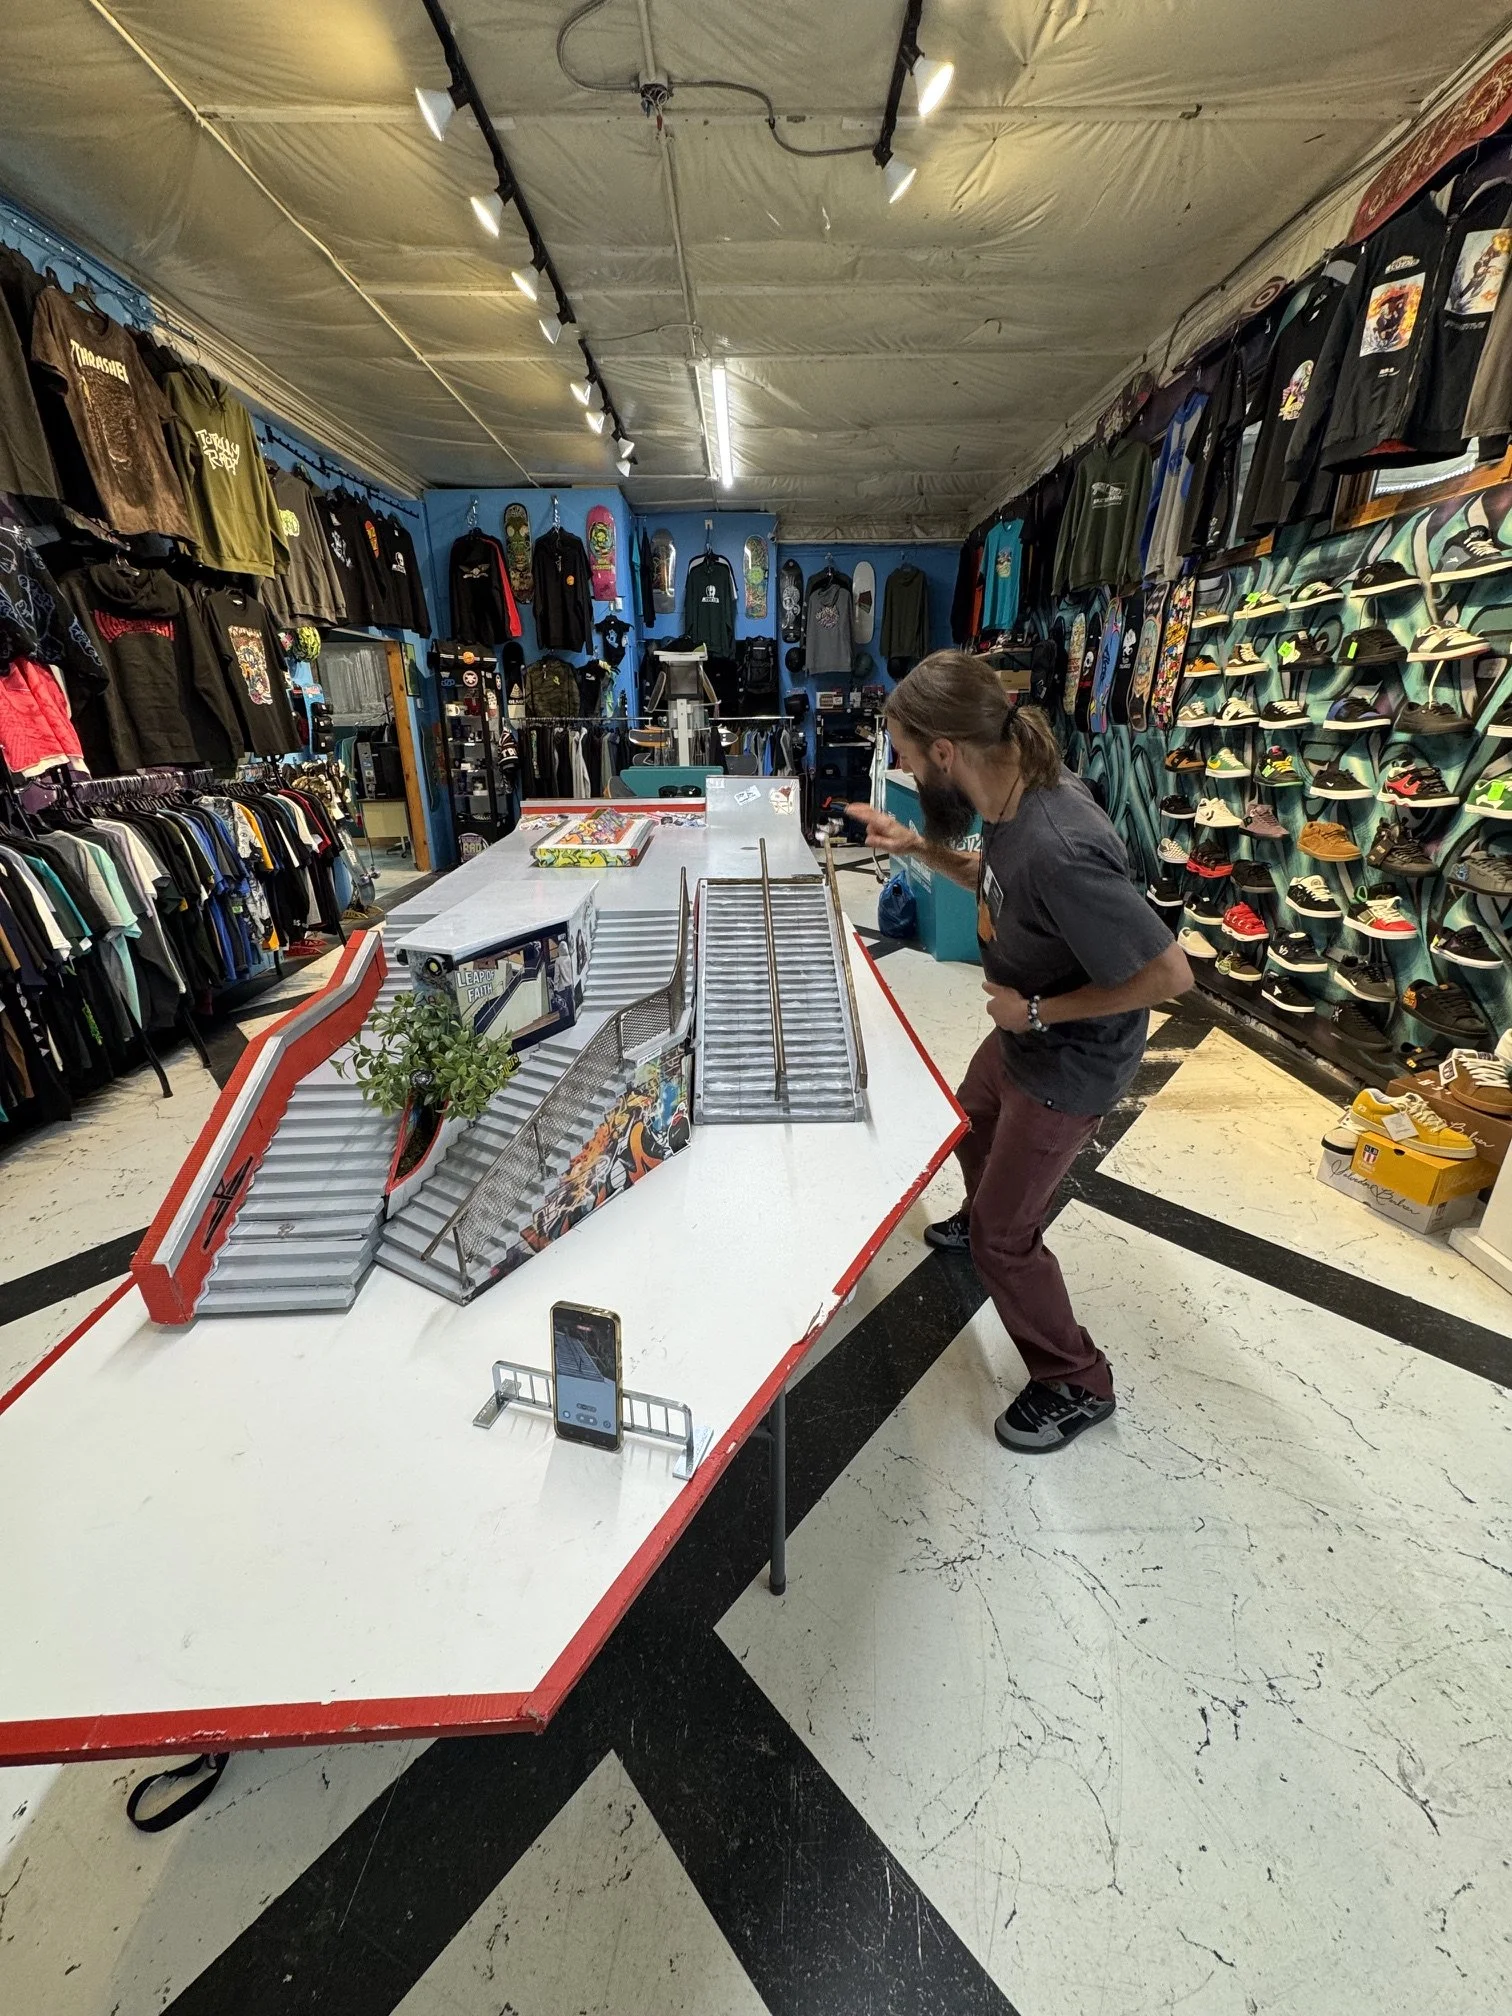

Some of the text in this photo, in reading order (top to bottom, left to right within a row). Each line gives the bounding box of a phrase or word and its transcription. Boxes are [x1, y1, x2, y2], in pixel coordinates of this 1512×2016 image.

[456, 970, 495, 988] LEAP OF
[467, 984, 493, 1003] FAITH
